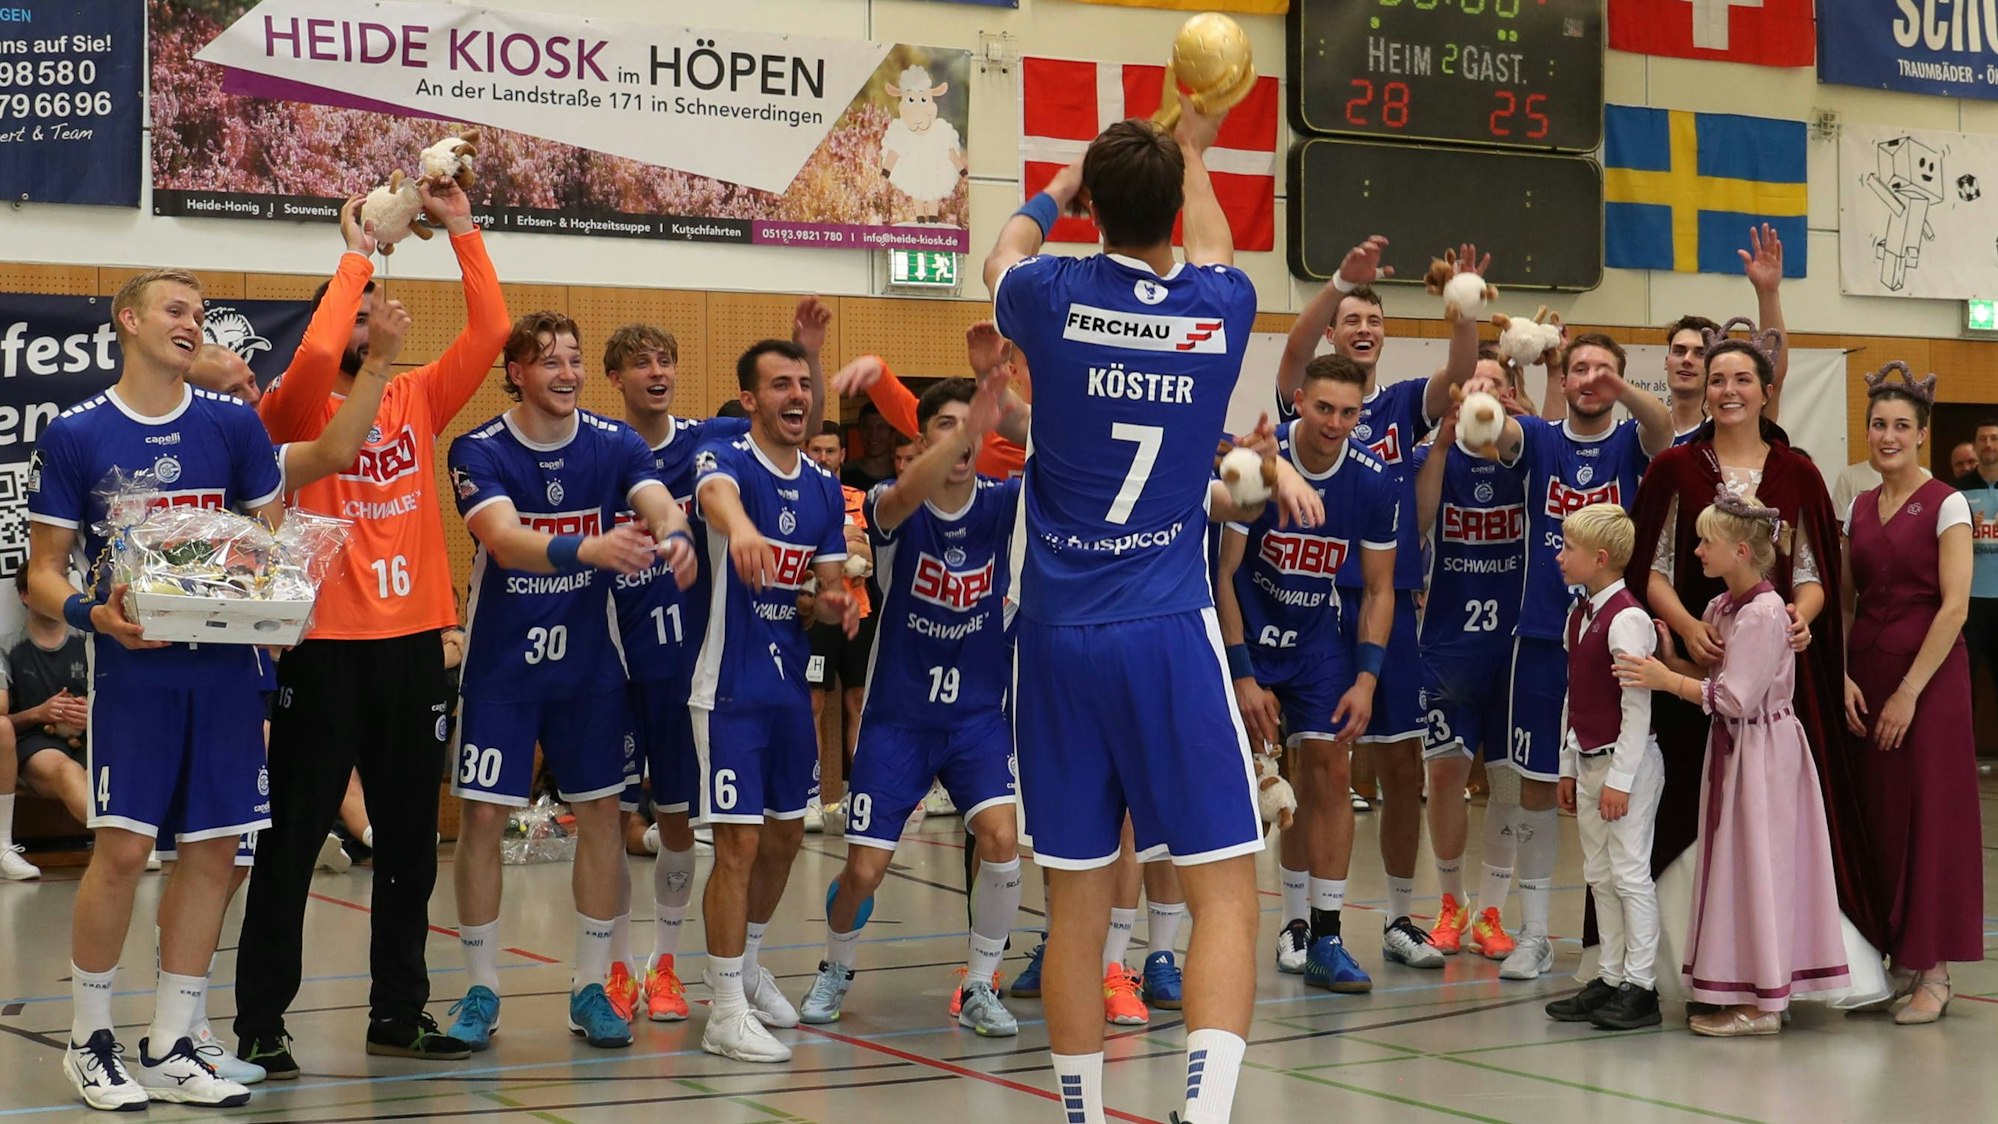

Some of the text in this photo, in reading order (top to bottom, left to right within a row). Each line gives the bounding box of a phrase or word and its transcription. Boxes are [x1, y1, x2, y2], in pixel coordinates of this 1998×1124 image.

[33, 35, 68, 53] auf
[72, 34, 112, 52] Sie!
[264, 15, 825, 99] HEIDE KIOSK im HÖPEN
[1368, 36, 1432, 76] HEIM
[1442, 44, 1458, 74] 2
[1898, 59, 1973, 83] TRAUMBÄDER
[416, 78, 823, 127] An der Landstraße 171 in Schneverdingen
[1346, 79, 1549, 139] 28 25
[32, 125, 44, 141] &
[50, 122, 93, 140] Team
[186, 199, 260, 215] Heide-Honig
[284, 203, 338, 217] Souvenirs
[516, 216, 557, 228] Erbsen-
[559, 218, 568, 229] &
[570, 218, 651, 234] Hochzeitssuppe
[672, 223, 742, 237] Kutschfahrten
[824, 231, 843, 242] 780
[863, 232, 958, 246] info@heide-kiosk.de
[1067, 313, 1171, 340] FERCHAU
[1087, 362, 1195, 404] KÖSTER
[145, 432, 181, 445] capelli
[1104, 421, 1164, 525] 7
[1262, 532, 1347, 575] SABO
[371, 555, 411, 599] 16
[650, 603, 683, 645] 11
[1463, 599, 1499, 632] 23
[524, 624, 568, 665] 30
[928, 665, 961, 704] 19
[460, 743, 503, 788] 30
[1514, 726, 1532, 766] 21
[97, 765, 111, 812] 4
[714, 768, 738, 811] 6
